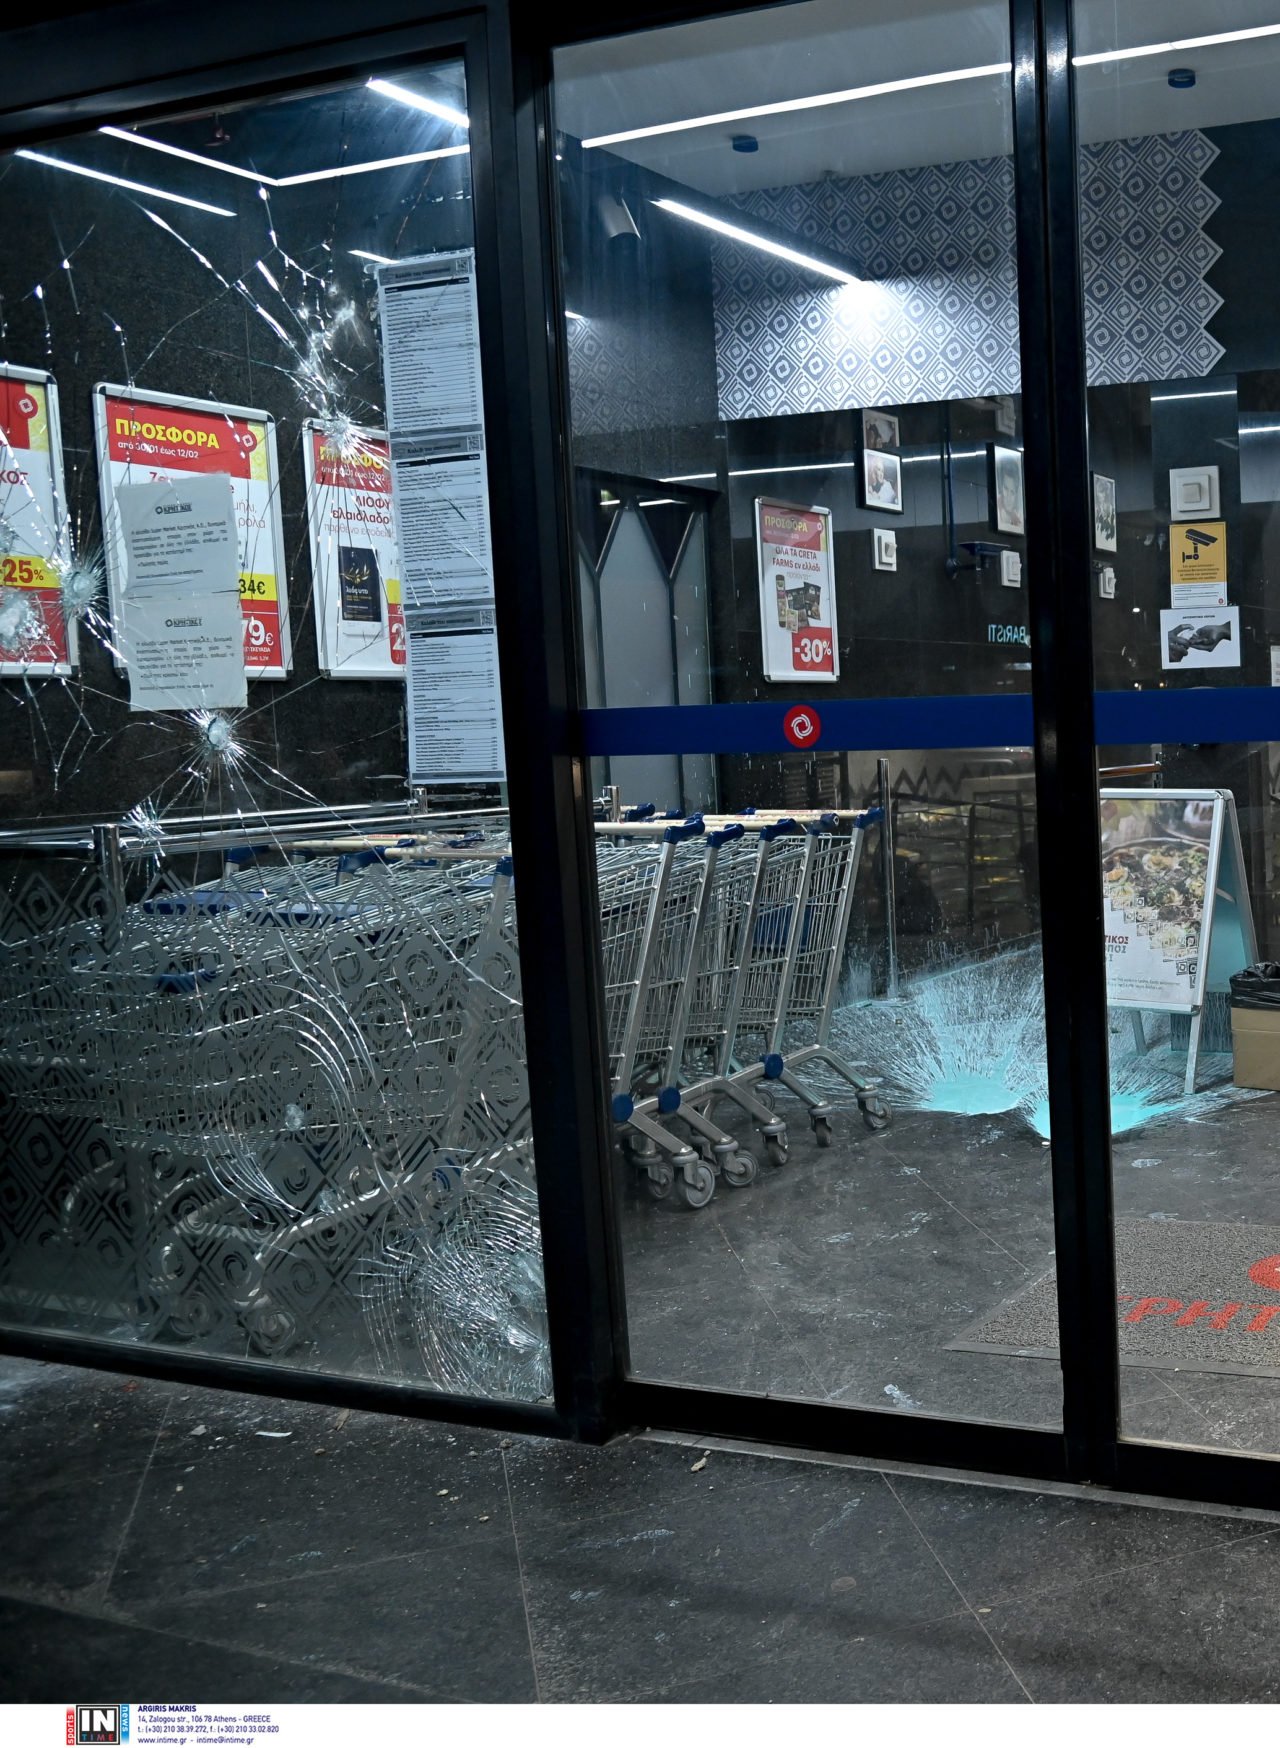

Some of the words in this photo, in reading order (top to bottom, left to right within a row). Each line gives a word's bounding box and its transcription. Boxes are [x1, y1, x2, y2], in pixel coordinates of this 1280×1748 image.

[115, 418, 220, 449] ΠΡΟΣΦΟΡΑ
[177, 448, 199, 459] 12/02
[764, 515, 809, 533] ΠΡΟΣΦΟΡΑ
[798, 550, 817, 560] CRETA
[772, 557, 794, 568] FARMS
[794, 638, 832, 663] -30%
